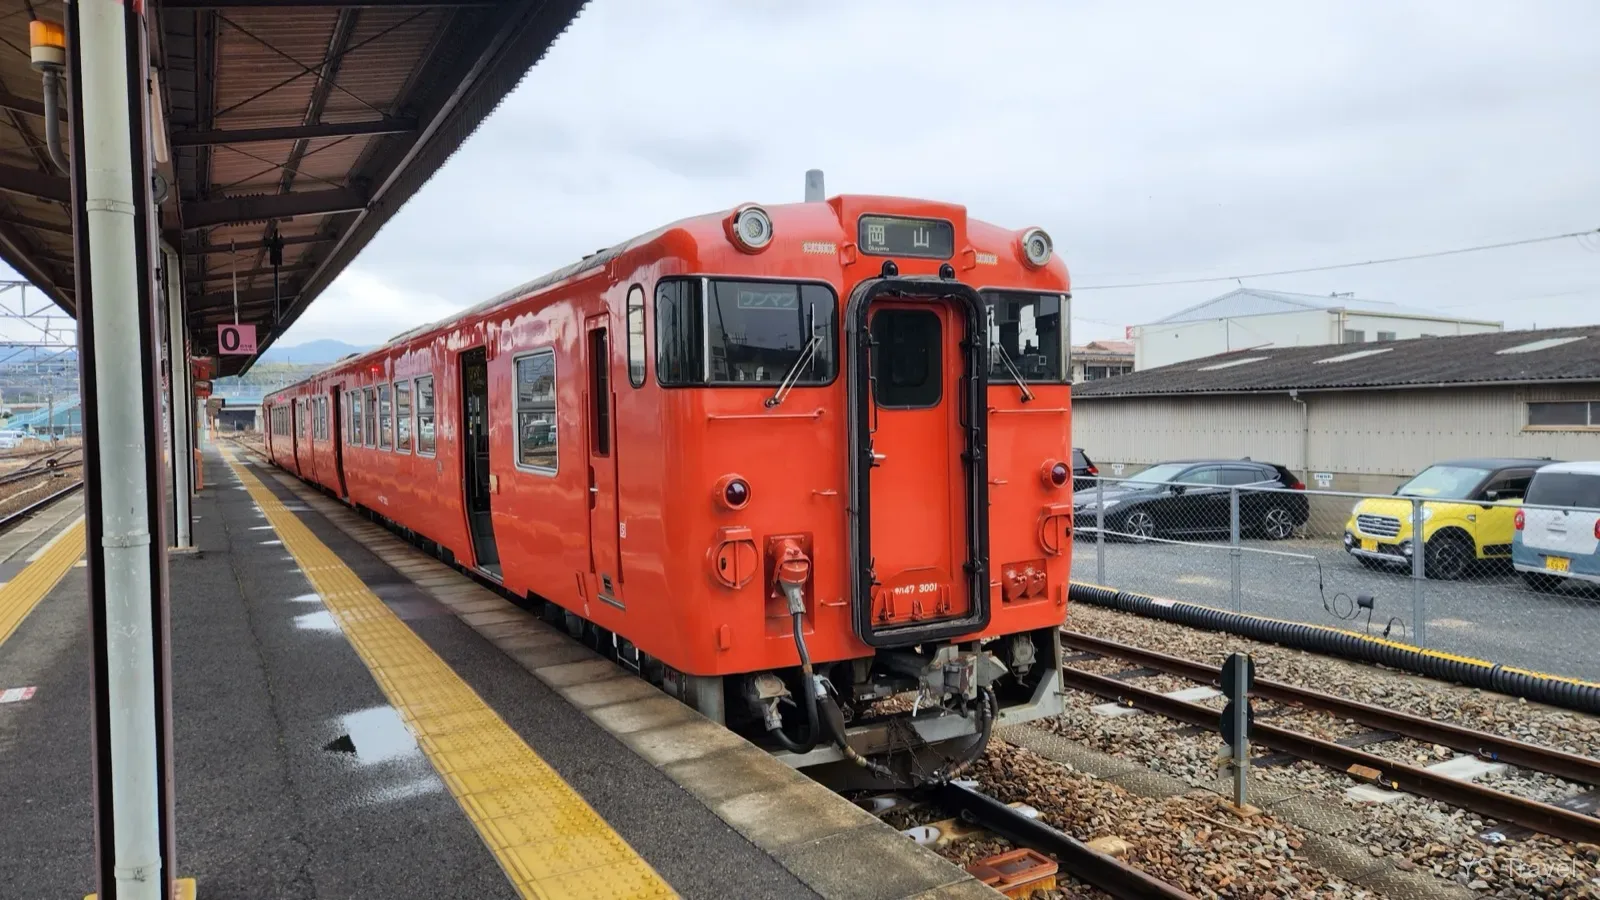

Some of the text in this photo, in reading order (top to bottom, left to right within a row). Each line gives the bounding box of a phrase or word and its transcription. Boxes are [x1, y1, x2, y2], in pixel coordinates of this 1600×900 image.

[868, 225, 929, 248] 岡山
[221, 327, 240, 351] 0
[919, 582, 938, 593] 3001
